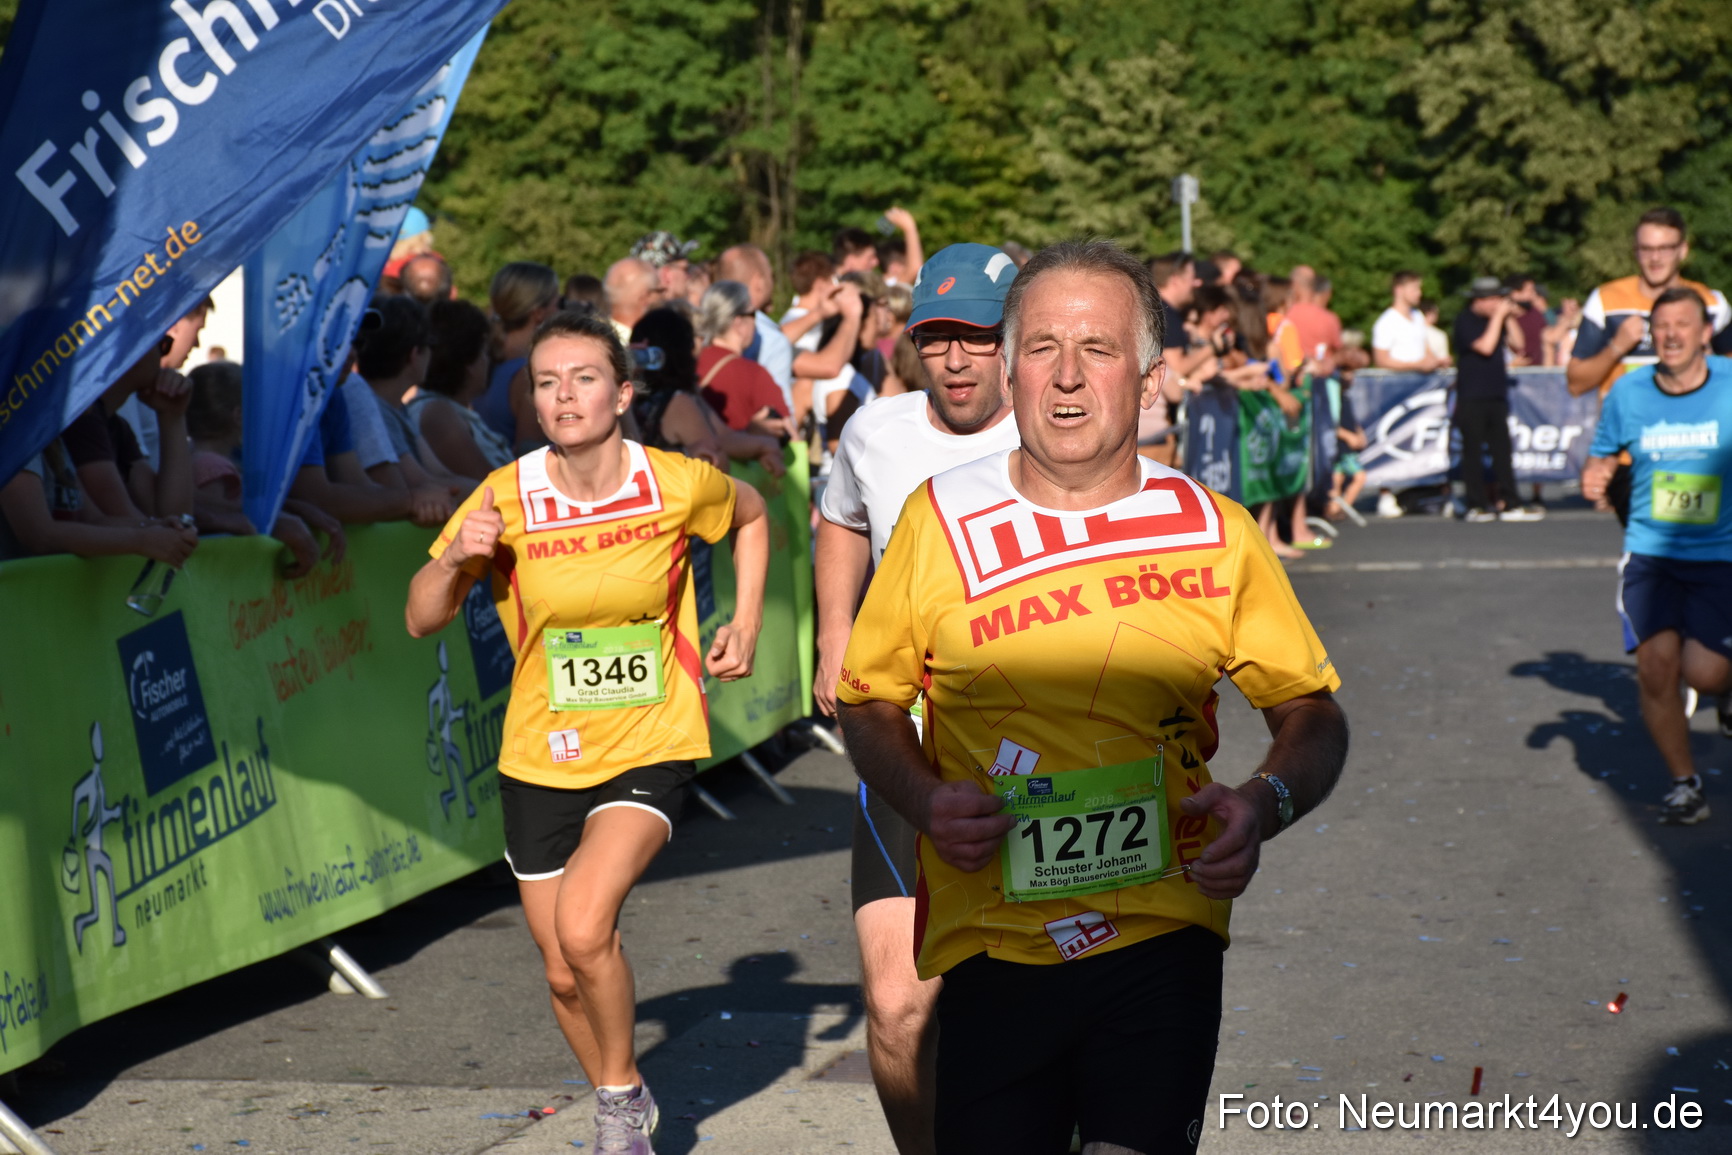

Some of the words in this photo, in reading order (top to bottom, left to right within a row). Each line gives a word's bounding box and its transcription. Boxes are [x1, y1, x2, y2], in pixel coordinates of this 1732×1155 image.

[1667, 490, 1704, 510] 791
[526, 536, 588, 560] MAX
[597, 522, 667, 550] BÖGL
[969, 583, 1093, 649] MAX
[1103, 563, 1231, 609] BÖGL
[140, 667, 187, 709] Fischer
[561, 654, 648, 688] 1346
[577, 688, 599, 697] Grad
[601, 686, 635, 696] Claudia
[122, 716, 276, 890] firmenlauf
[1018, 790, 1076, 806] firmenlauf
[1084, 794, 1115, 808] 2018
[1021, 805, 1149, 863] 1272
[1029, 879, 1048, 888] Max
[1050, 876, 1071, 887] Bögl
[1073, 869, 1120, 884] Bauservice
[1121, 862, 1147, 876] GmbH
[1034, 862, 1093, 878] Schuster
[1097, 853, 1142, 870] Johann
[136, 857, 208, 929] neumarkt
